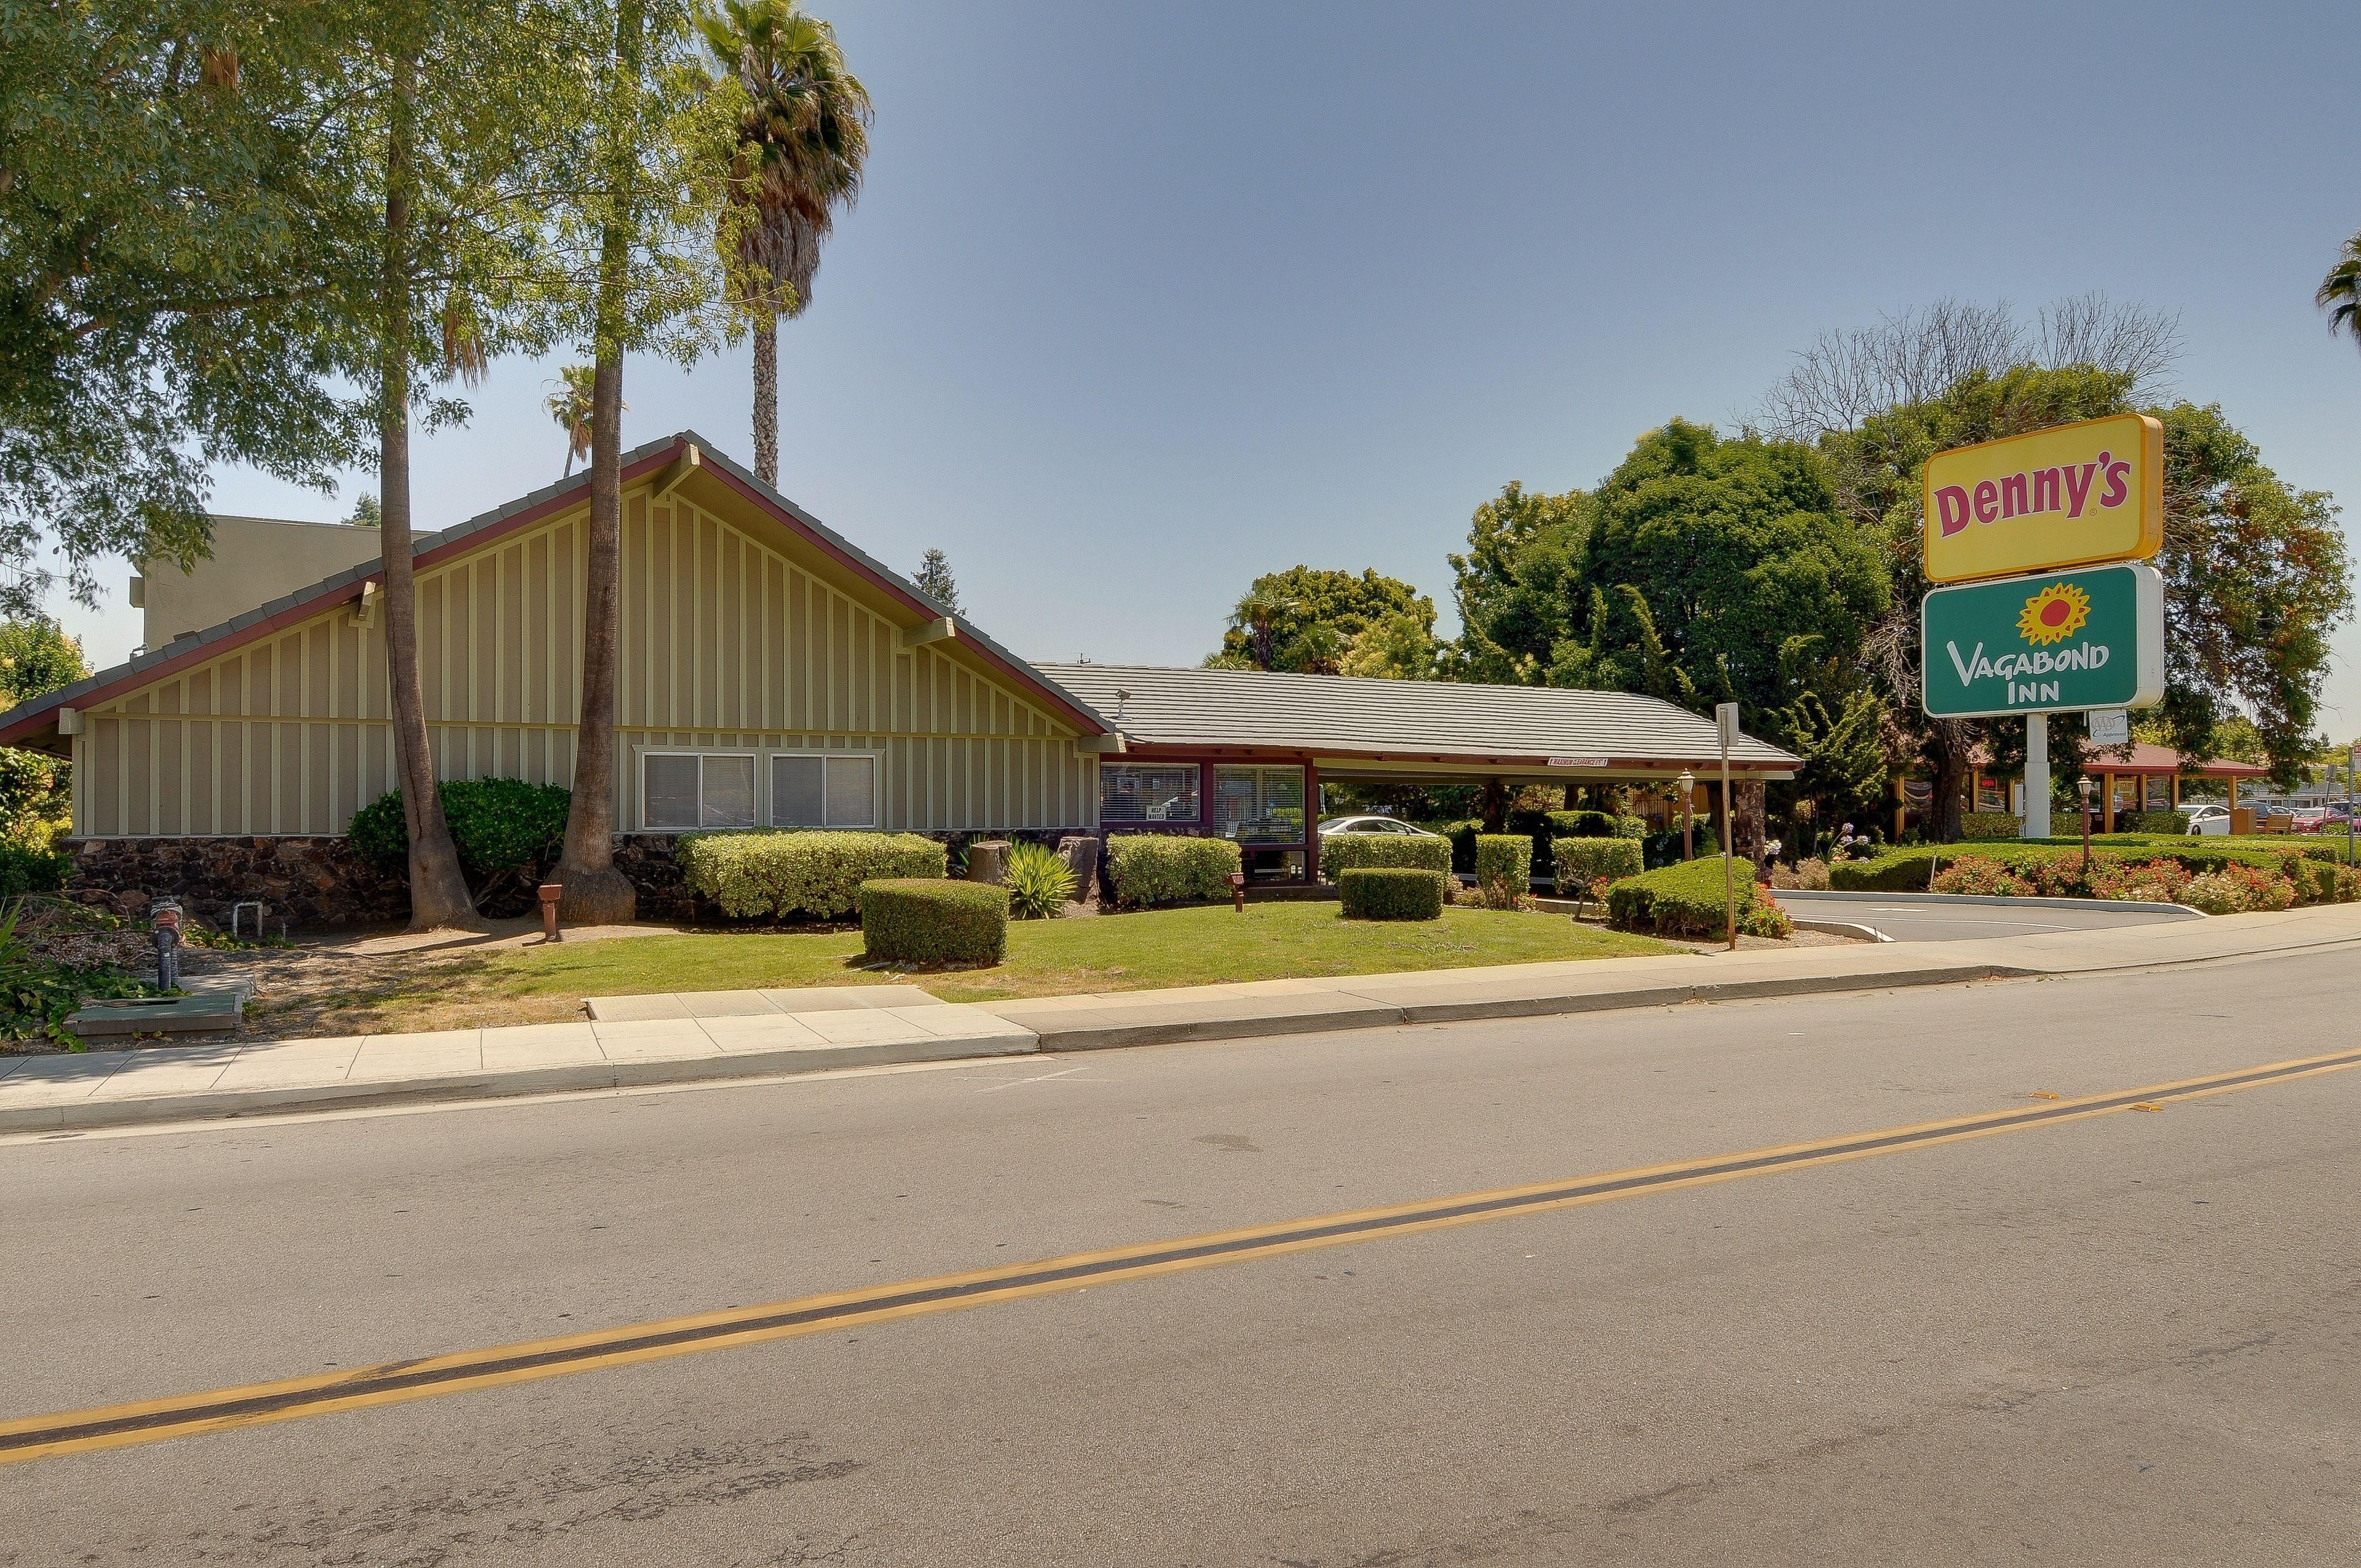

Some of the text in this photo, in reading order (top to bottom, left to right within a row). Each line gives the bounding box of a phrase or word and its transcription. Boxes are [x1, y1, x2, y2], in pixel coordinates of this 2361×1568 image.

[1933, 450, 2132, 539] Denny's
[1947, 641, 2110, 686] VAGABOND
[2008, 680, 2060, 705] INN
[2092, 718, 2114, 731] AAA
